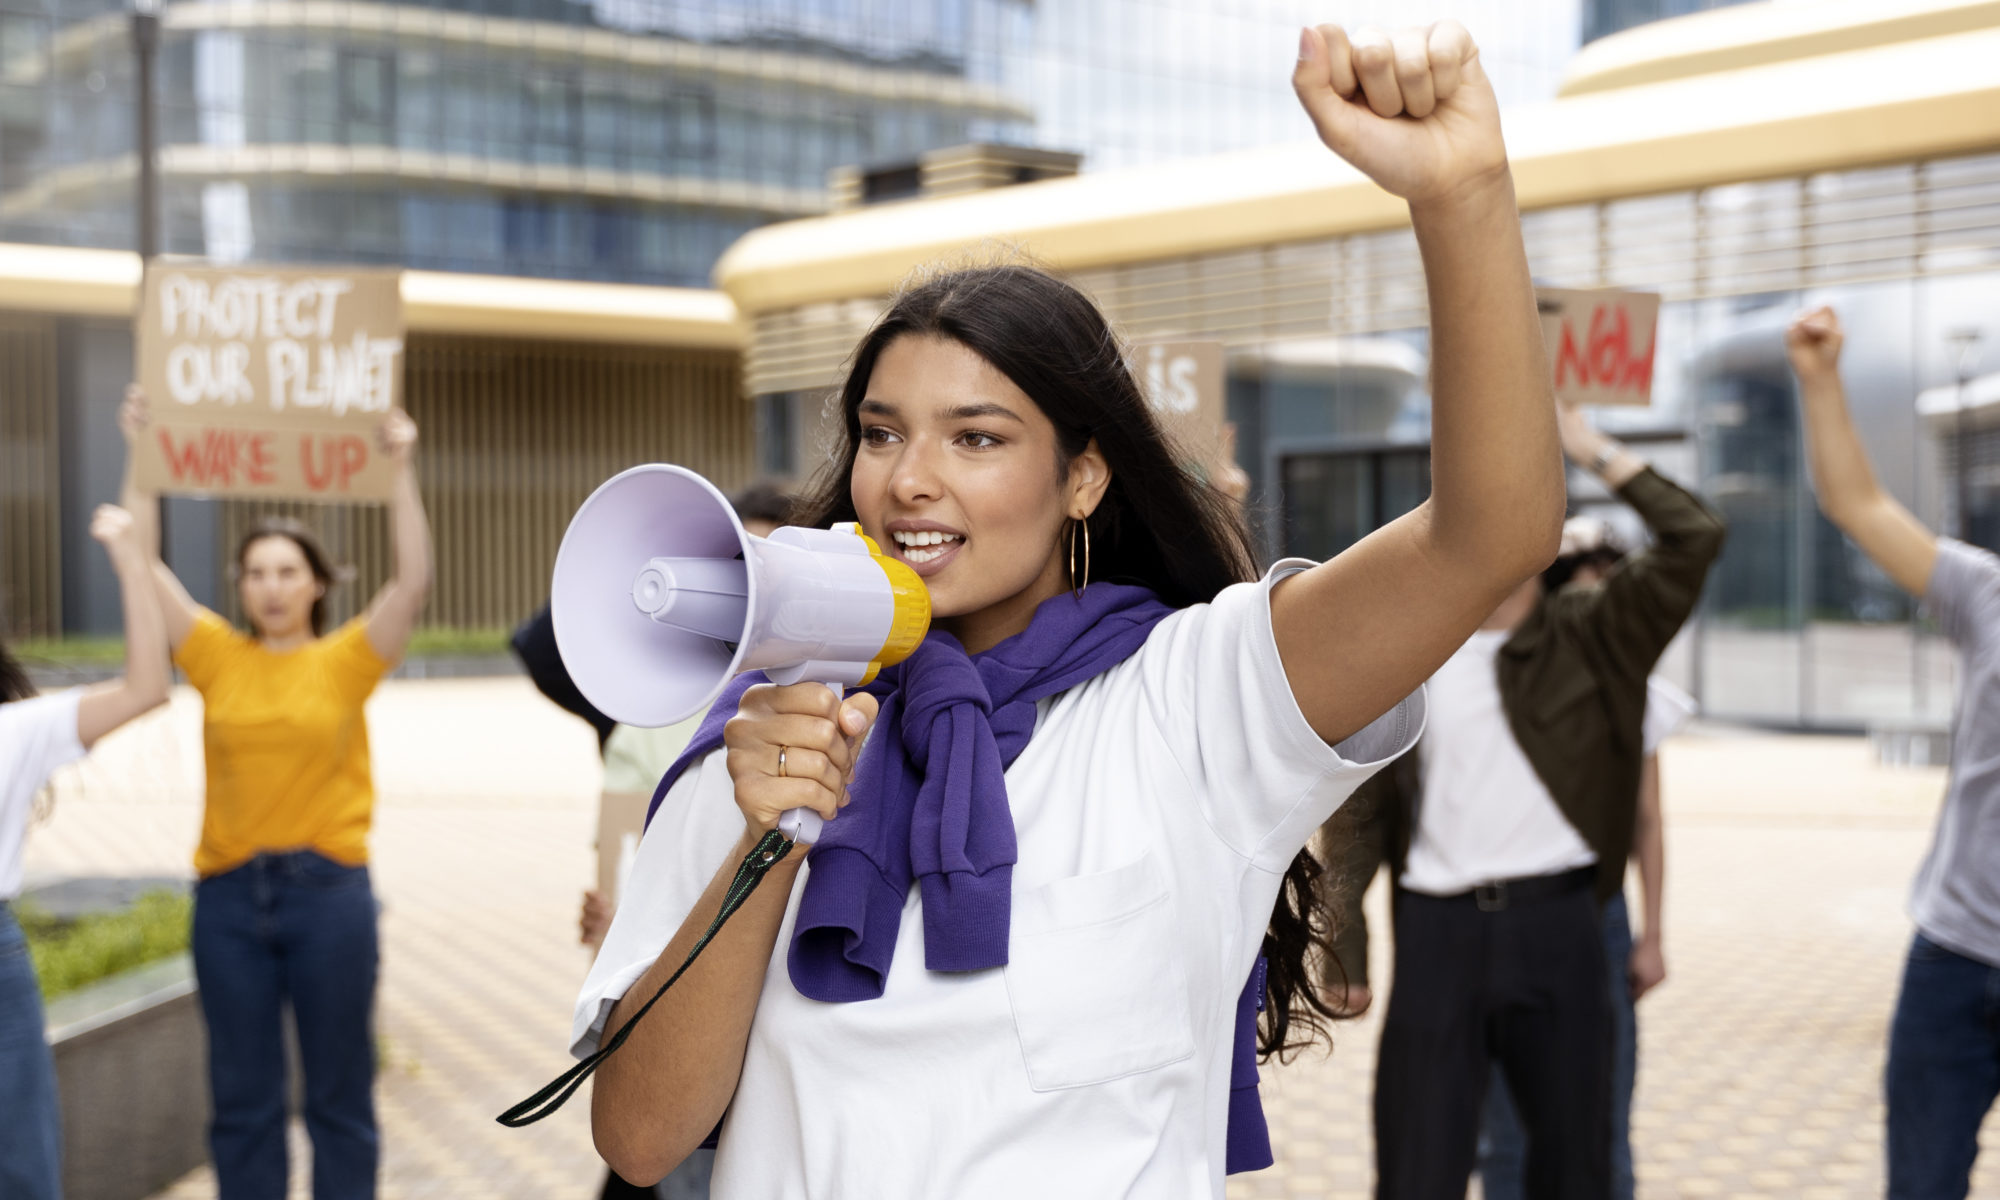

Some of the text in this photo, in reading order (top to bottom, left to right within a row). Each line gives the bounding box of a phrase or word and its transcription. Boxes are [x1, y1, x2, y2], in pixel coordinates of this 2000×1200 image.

[160, 273, 351, 339] PROTECT
[165, 333, 403, 415] OUR PLANET
[157, 426, 369, 491] WAKE UP
